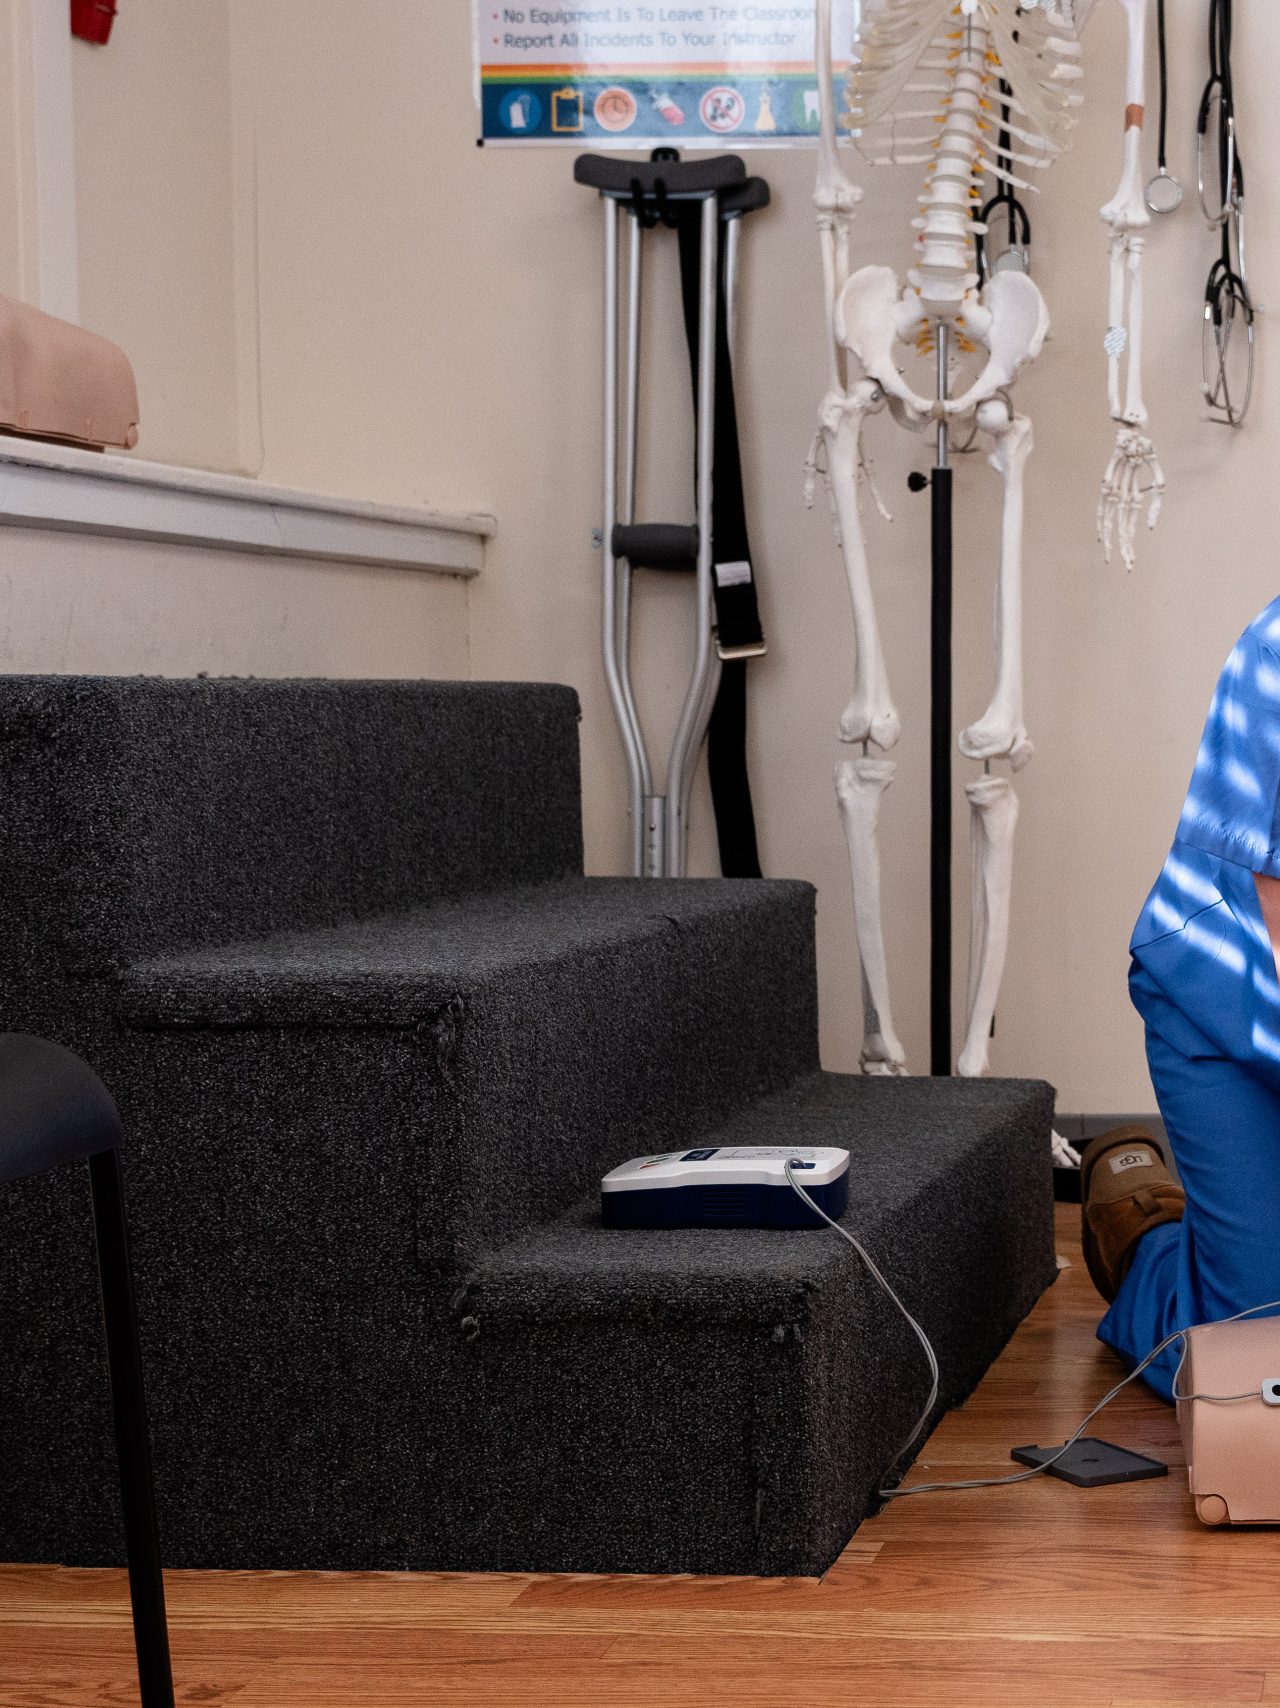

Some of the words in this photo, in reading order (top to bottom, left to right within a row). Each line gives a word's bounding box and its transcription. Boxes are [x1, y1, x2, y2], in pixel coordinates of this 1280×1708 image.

[503, 9, 525, 23] No
[530, 9, 611, 26] Equipment
[618, 8, 631, 23] Is
[638, 8, 654, 22] To
[660, 8, 704, 23] Leave
[710, 6, 737, 22] The
[504, 33, 556, 50] Report
[560, 33, 579, 48] All
[659, 32, 677, 47] To
[682, 32, 716, 47] Your
[1119, 1155, 1143, 1167] UGG
